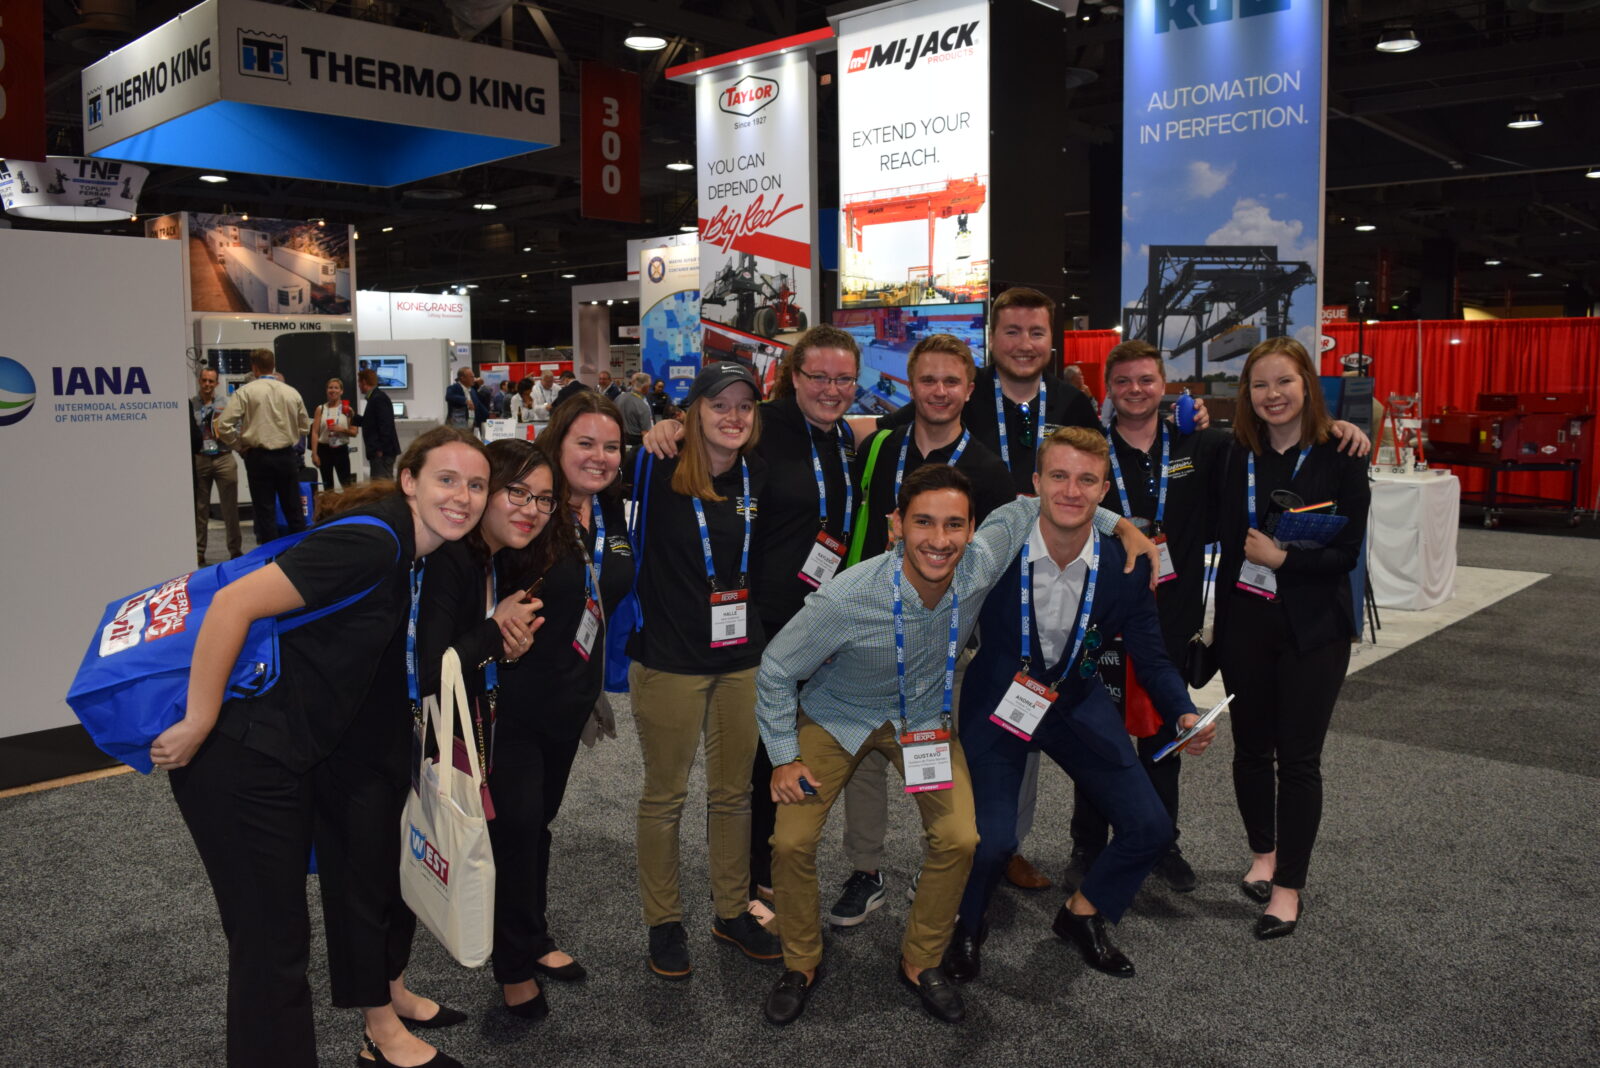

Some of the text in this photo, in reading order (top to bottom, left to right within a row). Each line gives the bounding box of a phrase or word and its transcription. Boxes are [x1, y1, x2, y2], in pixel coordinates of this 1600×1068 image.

[868, 20, 980, 70] MI-JACK
[927, 47, 974, 64] PRODUCTS
[106, 37, 211, 116] THERMO KING
[301, 46, 546, 116] THERMO KING
[725, 84, 773, 107] TAYLOR
[1147, 69, 1301, 113] AUTOMATION
[733, 116, 767, 130] Since 1927
[852, 111, 971, 148] EXTEND YOUR
[1139, 103, 1309, 145] IN PERFECTION.
[602, 96, 622, 195] 300
[707, 151, 765, 176] YOU CAN
[880, 146, 940, 172] REACH.
[708, 173, 782, 200] DEPEND ON
[703, 193, 803, 254] Big Red
[396, 301, 464, 312] KONECRANES
[252, 322, 321, 331] THERMO KING
[52, 366, 152, 396] IANA
[54, 401, 179, 412] INTERMODAL ASSOCIATION
[55, 413, 148, 423] OF NORTH AMERICA
[1016, 695, 1036, 709] ANDREA
[914, 732, 936, 742] EXPO
[914, 752, 941, 760] GUSTAVO
[412, 831, 448, 879] WEST
